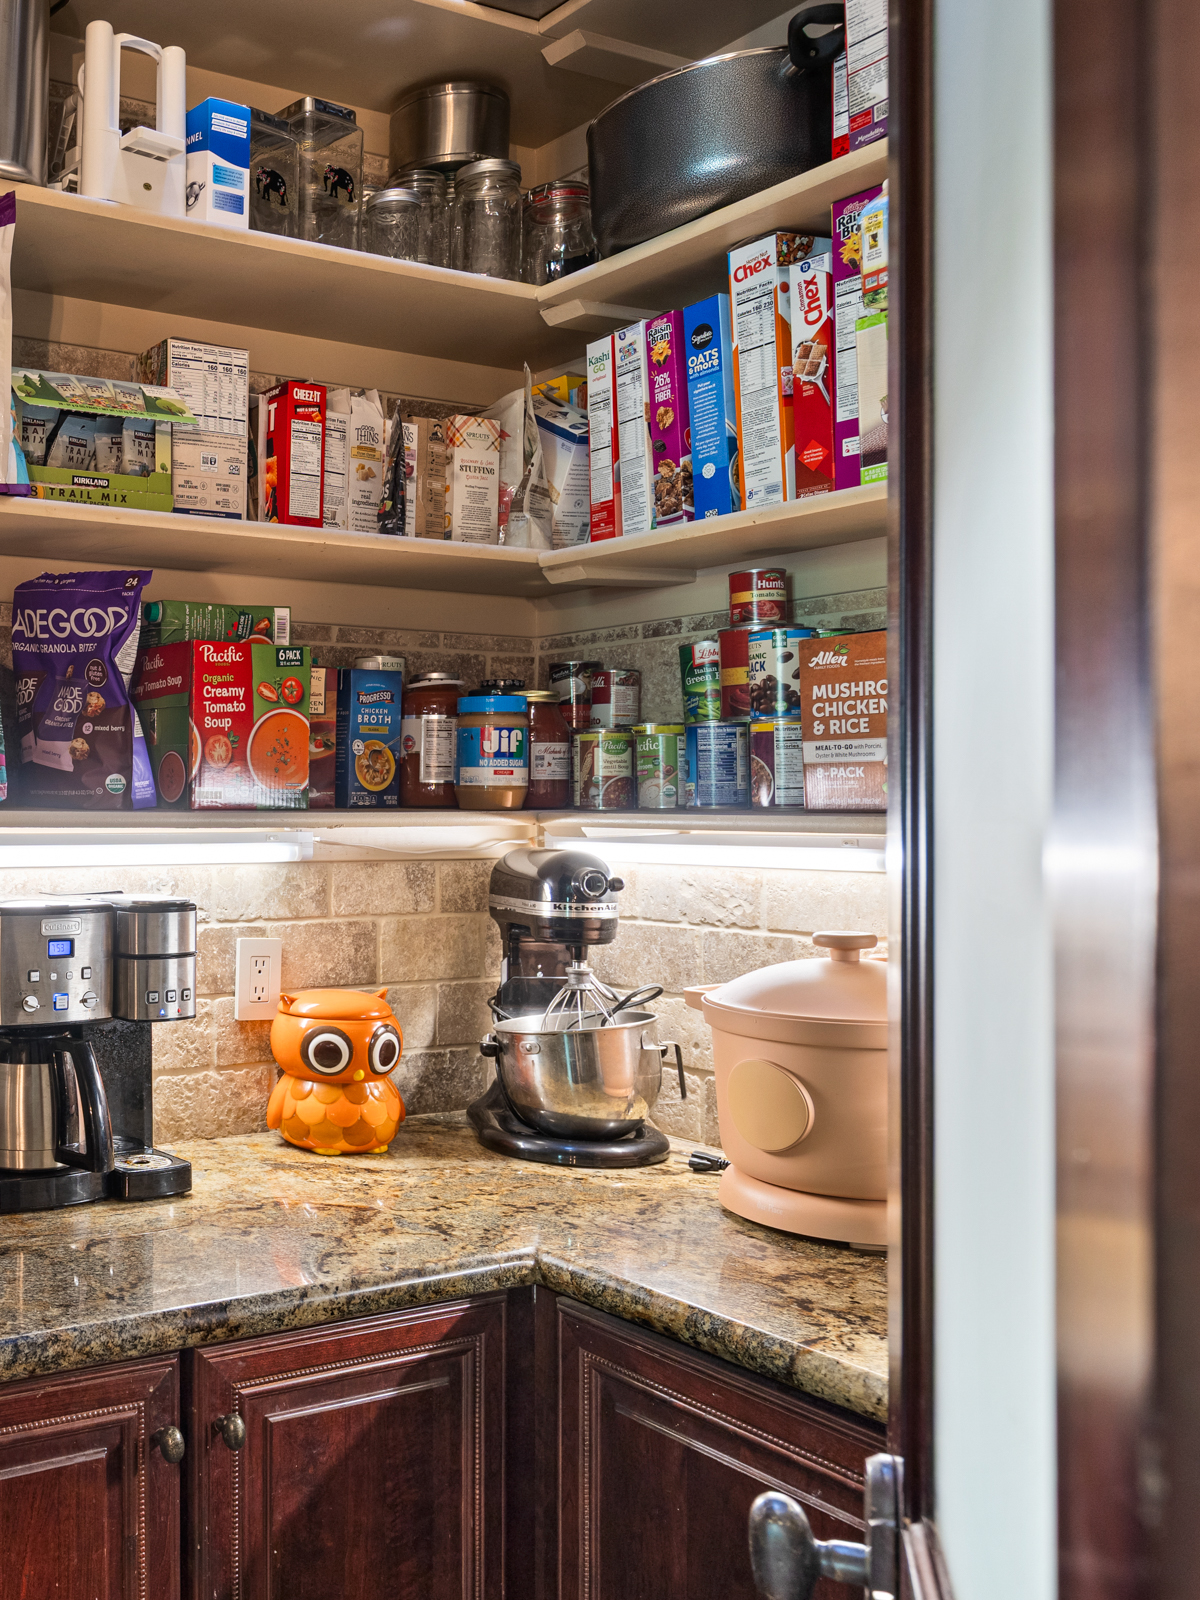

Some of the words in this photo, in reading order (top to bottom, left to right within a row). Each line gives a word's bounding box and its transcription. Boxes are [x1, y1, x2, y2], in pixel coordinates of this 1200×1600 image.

[746, 255, 760, 266] Honey
[760, 250, 768, 258] Nut
[733, 254, 773, 283] Chex
[736, 286, 758, 297] Nutrition
[758, 281, 773, 289] Facts
[797, 282, 806, 312] Cinnamon
[803, 273, 823, 326] Chex
[648, 323, 672, 341] Raisin
[651, 331, 671, 347] Bran
[588, 350, 610, 367] Kashi
[688, 348, 719, 367] OATS
[593, 363, 606, 374] GO
[694, 358, 719, 373] more
[592, 374, 607, 382] original
[654, 371, 671, 389] 26%
[689, 371, 699, 380] with
[700, 366, 720, 377] almonds
[655, 389, 671, 403] FIBER
[22, 435, 45, 444] MIX
[355, 427, 379, 444] THINS
[466, 431, 490, 440] SPROUTS
[65, 445, 92, 457] TRAIL
[137, 448, 155, 458] MIX
[68, 456, 85, 465] MIX
[459, 464, 495, 475] STUFFING
[74, 476, 109, 487] KIRKLAND
[49, 487, 93, 500] TRAIL
[101, 492, 128, 503] MIX
[352, 498, 379, 507] ingredients
[125, 577, 138, 587] 24
[12, 606, 129, 639] ADEGOOD
[237, 614, 245, 636] EXPLORE
[40, 643, 77, 654] GRANOLA
[79, 642, 98, 653] BITES
[199, 644, 245, 663] Pacific
[278, 649, 286, 660] 6
[286, 649, 301, 660] PACK
[141, 653, 165, 671] Pacific
[808, 650, 848, 668] Allen
[88, 670, 103, 678] gluten
[694, 666, 717, 674] Italian
[144, 677, 167, 692] Tomato
[167, 675, 183, 687] Soup
[202, 673, 234, 685] Organic
[686, 673, 712, 685] Green
[57, 686, 83, 700] MADE
[203, 686, 245, 700] Creamy
[812, 679, 888, 700] MUSHRO
[360, 691, 391, 704] PROGRESSO
[53, 698, 83, 714] GOOD
[203, 701, 246, 713] Tomato
[204, 716, 232, 731] Soup
[357, 714, 392, 724] BROTH
[813, 720, 825, 735] &
[829, 718, 870, 735] RICE
[483, 729, 523, 753] Jif
[603, 740, 627, 752] Pacific
[815, 743, 853, 751] MEAL-TO-GO
[479, 759, 488, 767] NO
[488, 759, 508, 767] ADDED
[509, 759, 524, 767] SUGAR
[603, 758, 628, 766] Vegetable
[816, 766, 864, 779] 8-PACK
[553, 903, 618, 912] KitchenAid
[44, 921, 79, 931] Cuisinart
